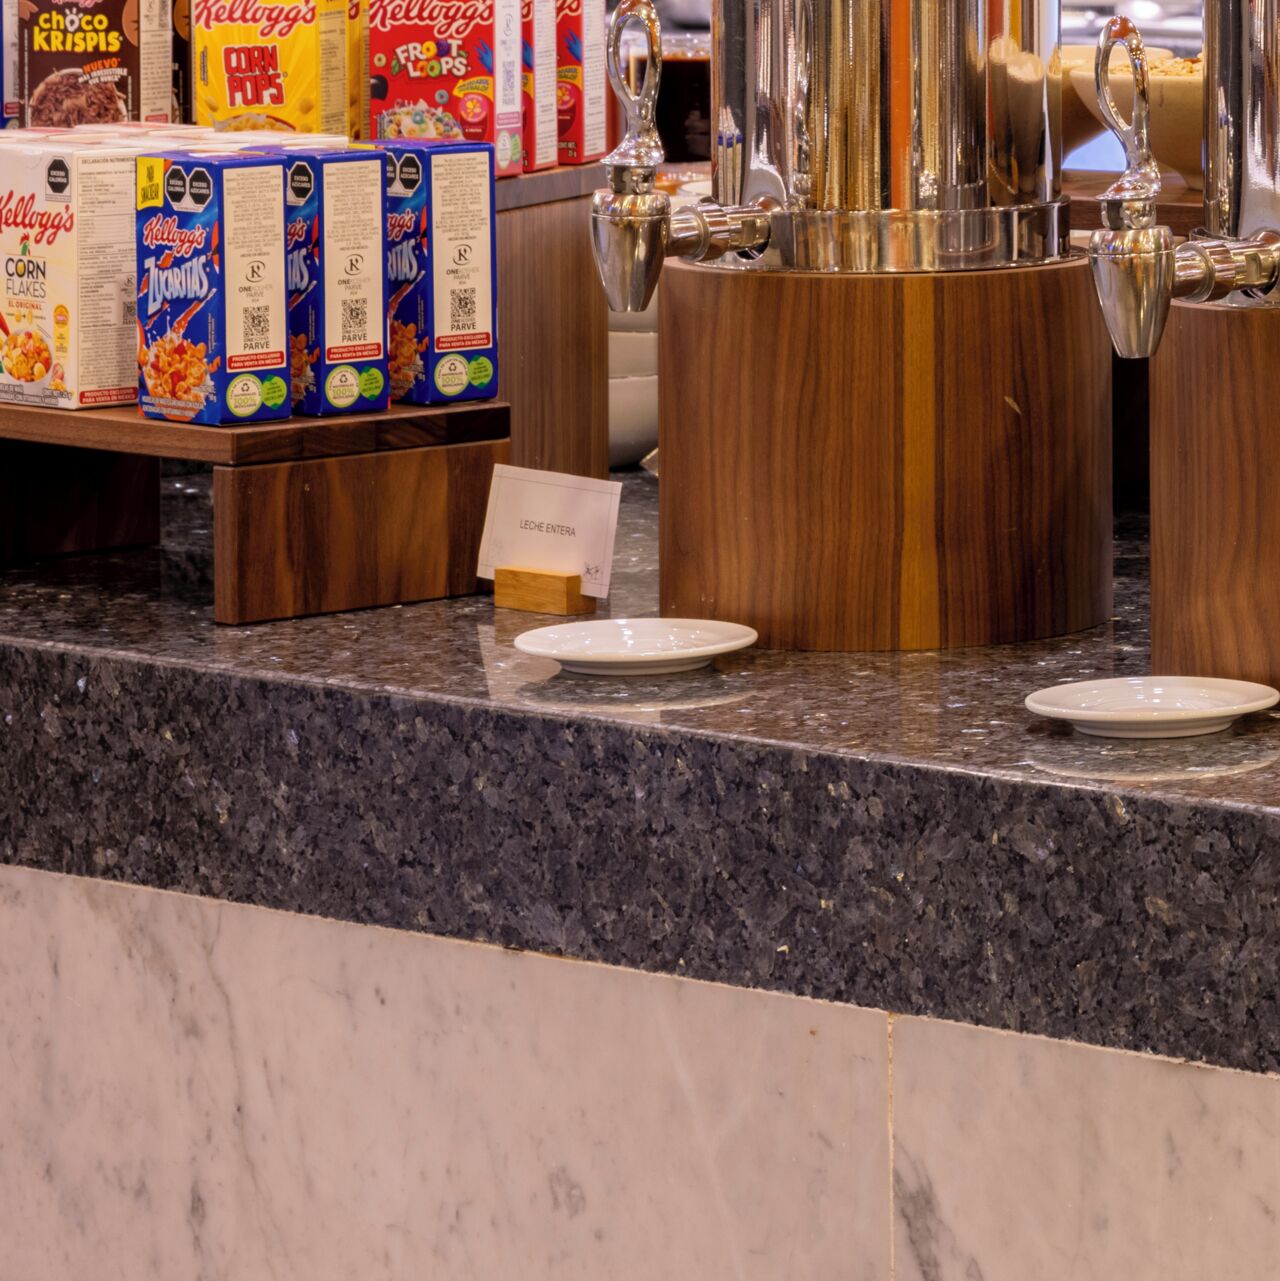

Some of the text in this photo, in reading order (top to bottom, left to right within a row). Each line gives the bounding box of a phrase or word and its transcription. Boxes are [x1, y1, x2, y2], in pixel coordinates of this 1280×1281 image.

[38, 8, 109, 33] choco
[33, 26, 121, 53] KRISPIS
[223, 45, 279, 76] CORN
[395, 39, 463, 65] FROOT
[407, 56, 469, 78] LOOPS
[227, 72, 285, 108] POPS
[143, 212, 206, 258] Kellogg's
[5, 257, 46, 280] CORN
[5, 278, 47, 299] FLAKES
[144, 253, 209, 317] ZUCARITAS
[341, 333, 368, 343] PARVE
[450, 322, 477, 332] PARVE
[243, 341, 270, 351] PARVE
[519, 519, 576, 537] LECHE ENTERA
